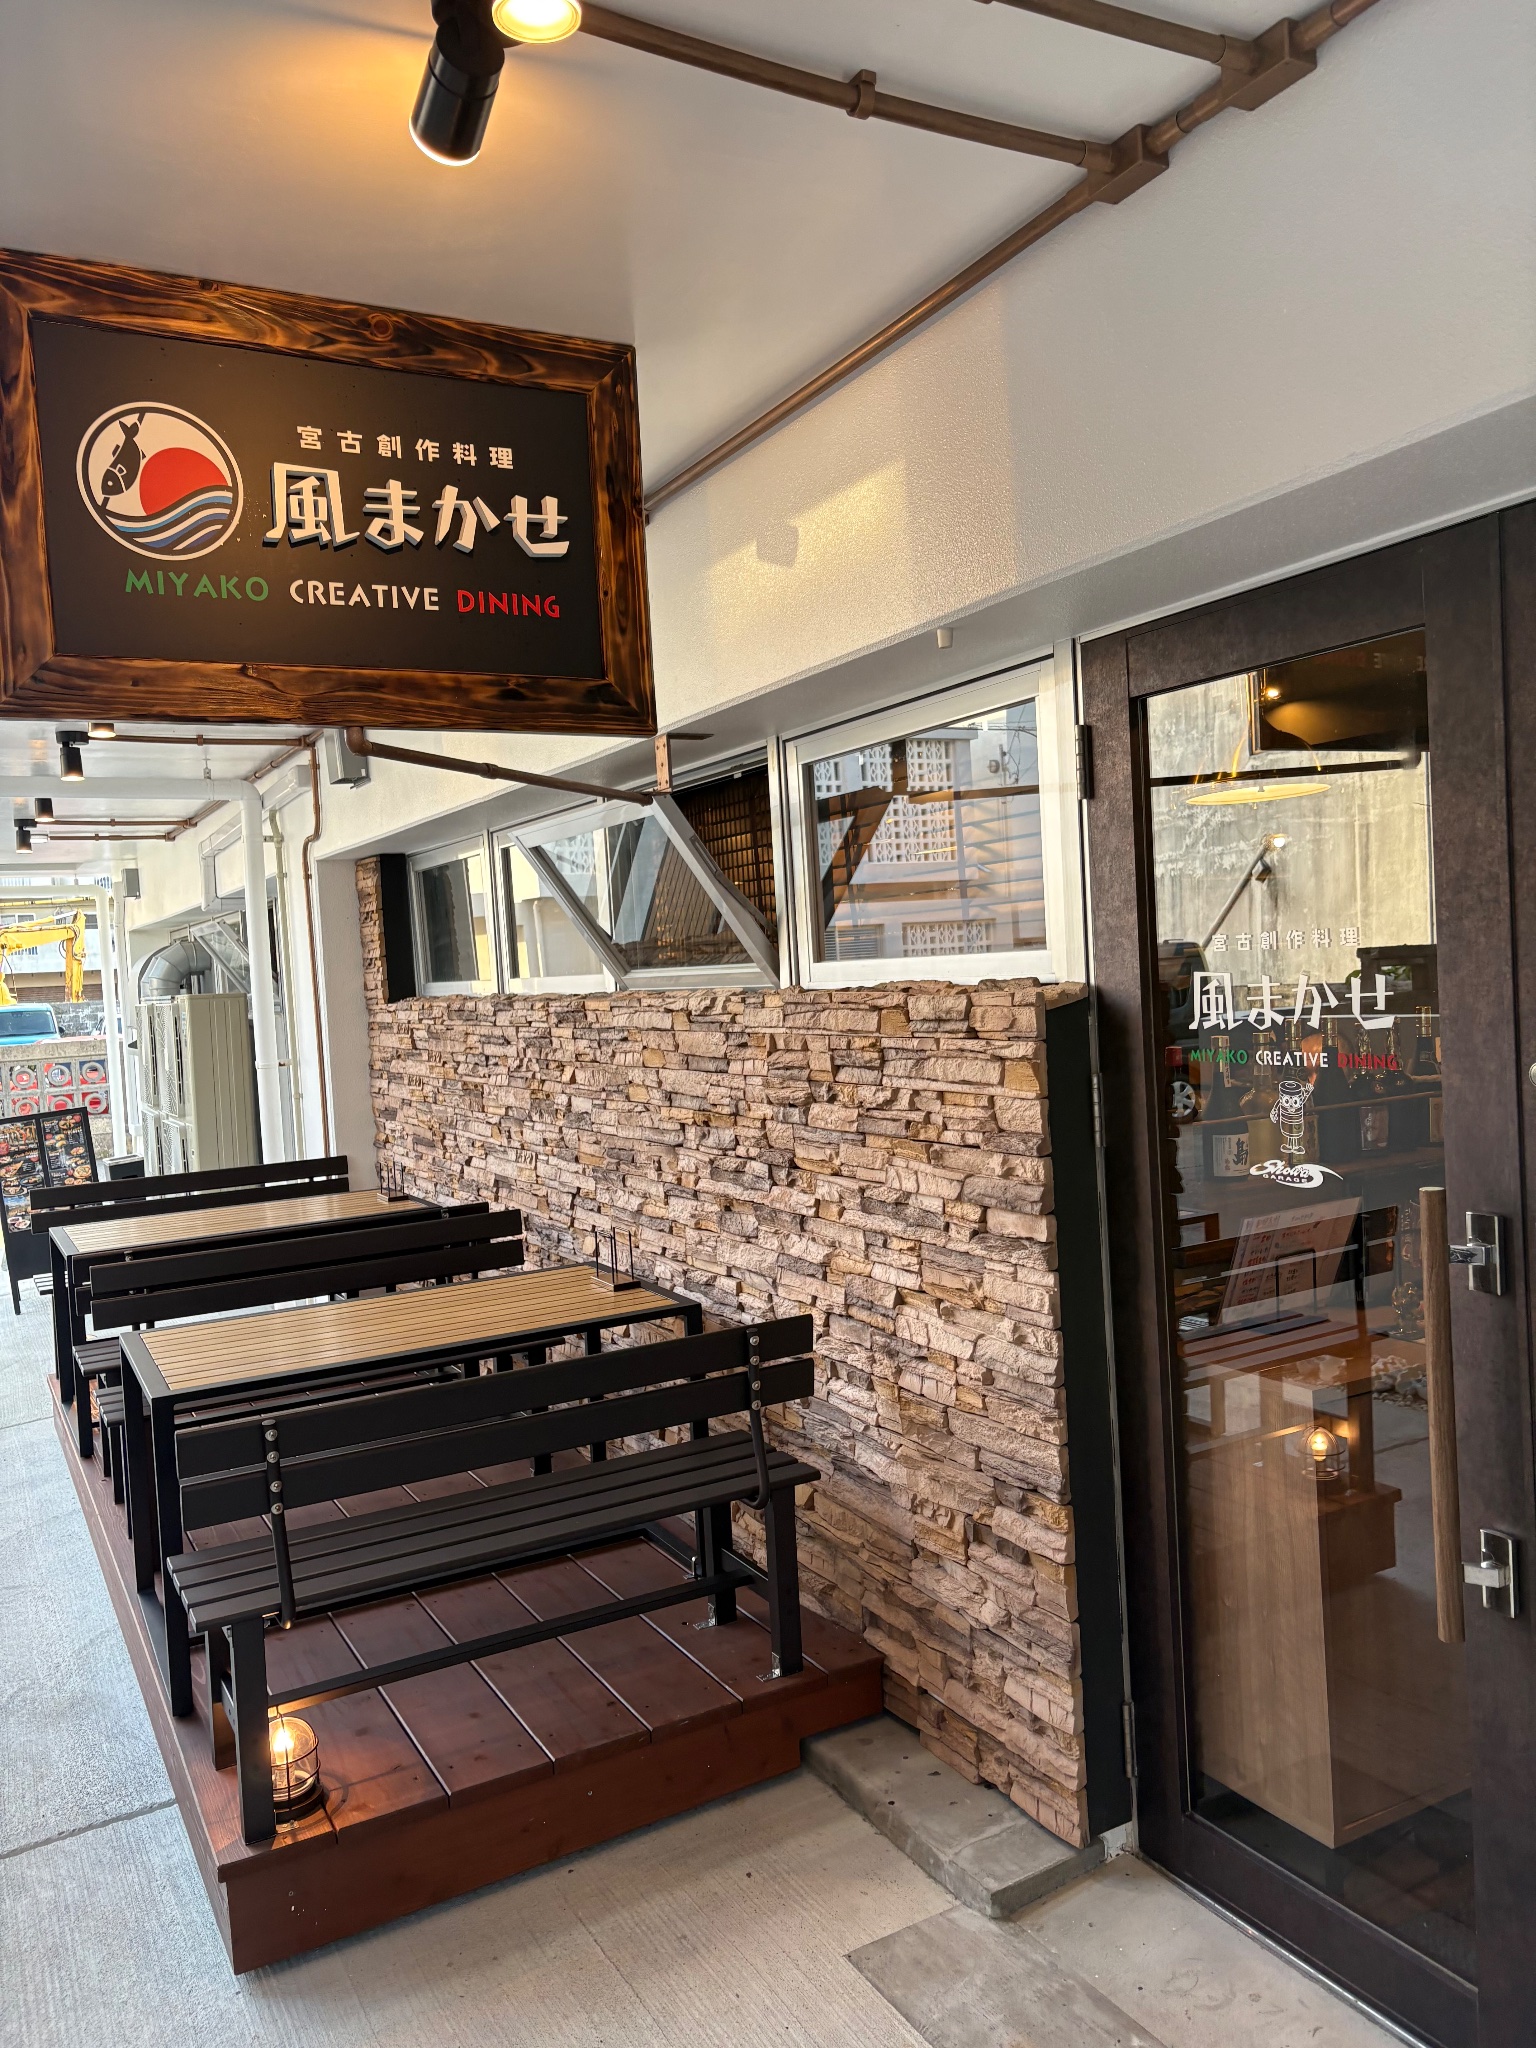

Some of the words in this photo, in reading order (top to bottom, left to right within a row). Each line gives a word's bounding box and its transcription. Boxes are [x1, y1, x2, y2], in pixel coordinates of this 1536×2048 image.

[296, 425, 515, 470] 宮古創作料理
[262, 461, 571, 559] 風まかせ
[125, 568, 270, 602] MIYAKO
[289, 579, 441, 612] CREATIVE
[457, 589, 562, 619] DINING
[1211, 926, 1362, 952] 宮古創作料理
[1188, 970, 1397, 1031] 風まかせ
[1190, 1049, 1249, 1065] MIYAKO
[1255, 1050, 1329, 1068] CREATIVE
[1337, 1053, 1399, 1071] DINING
[1249, 1159, 1310, 1178] Showa
[1262, 1173, 1308, 1184] GARAGE
